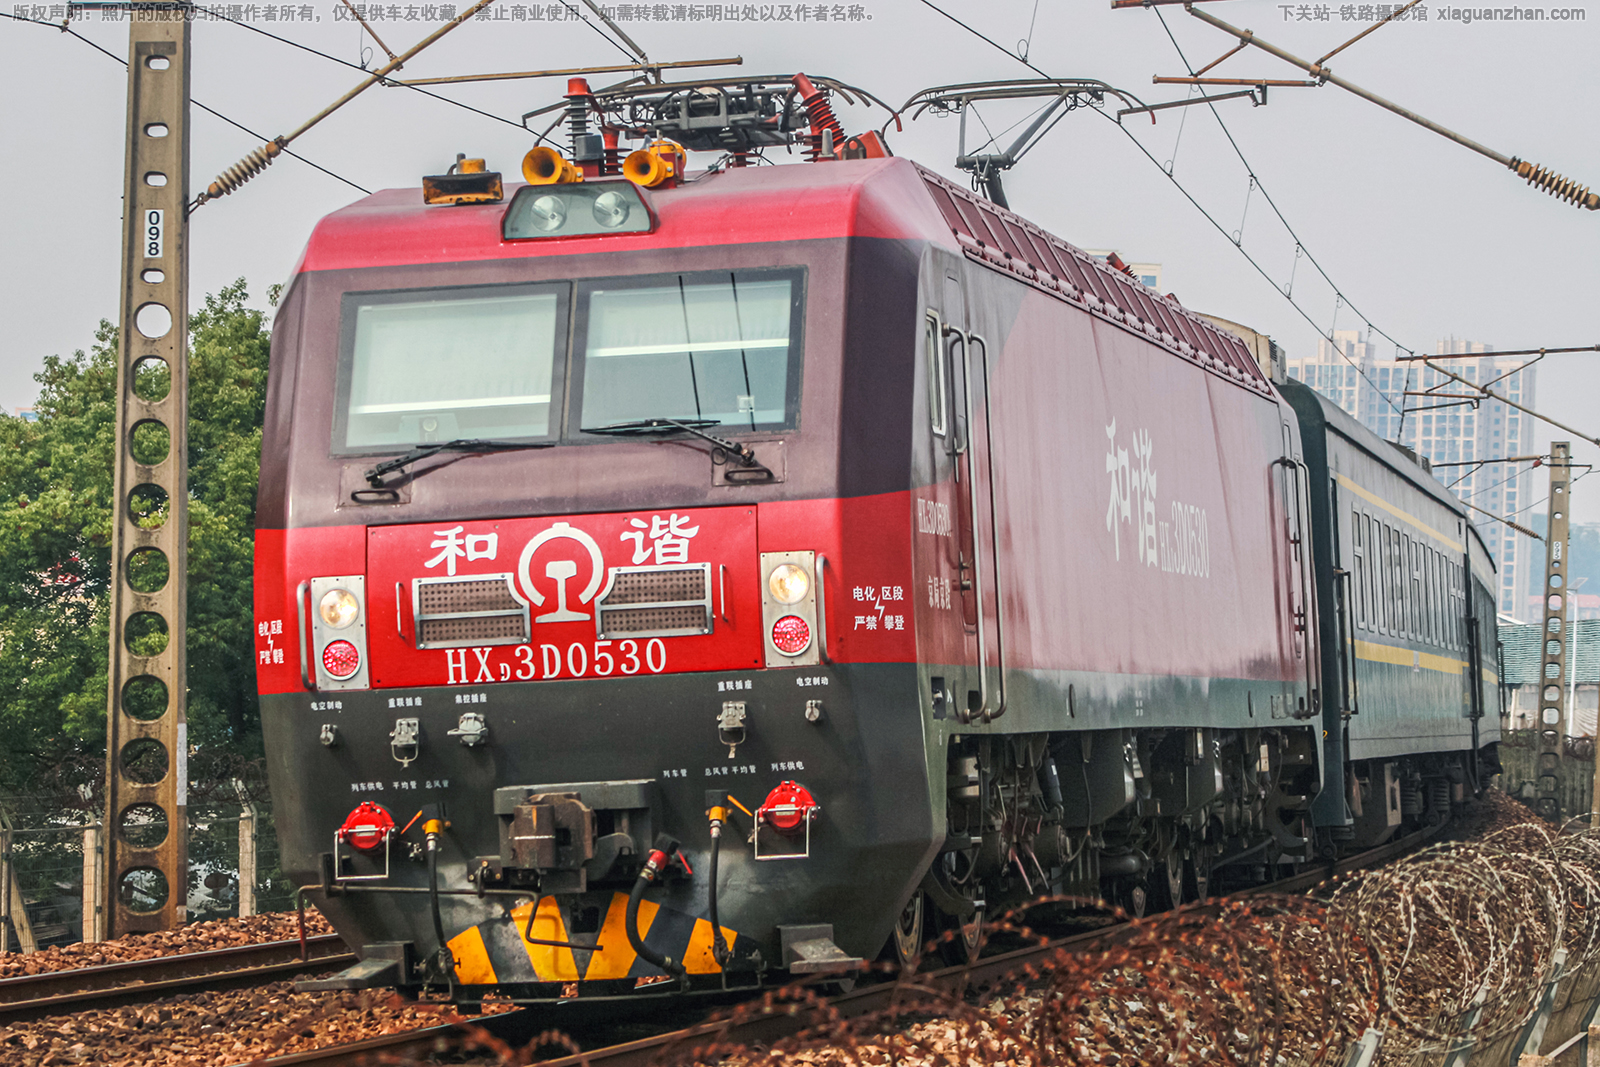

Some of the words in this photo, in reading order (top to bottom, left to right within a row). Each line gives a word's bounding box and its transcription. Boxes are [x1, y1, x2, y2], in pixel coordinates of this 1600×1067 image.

[148, 210, 160, 256] 098
[1105, 415, 1158, 568] 和谐
[445, 638, 667, 685] HXD3D0530
[717, 680, 753, 692] 重联插座
[796, 676, 829, 687] 电空制动
[310, 701, 343, 711] 电空制动
[388, 696, 423, 708] 重联插座
[771, 760, 805, 772] 列车供电
[351, 781, 384, 793] 列车供电
